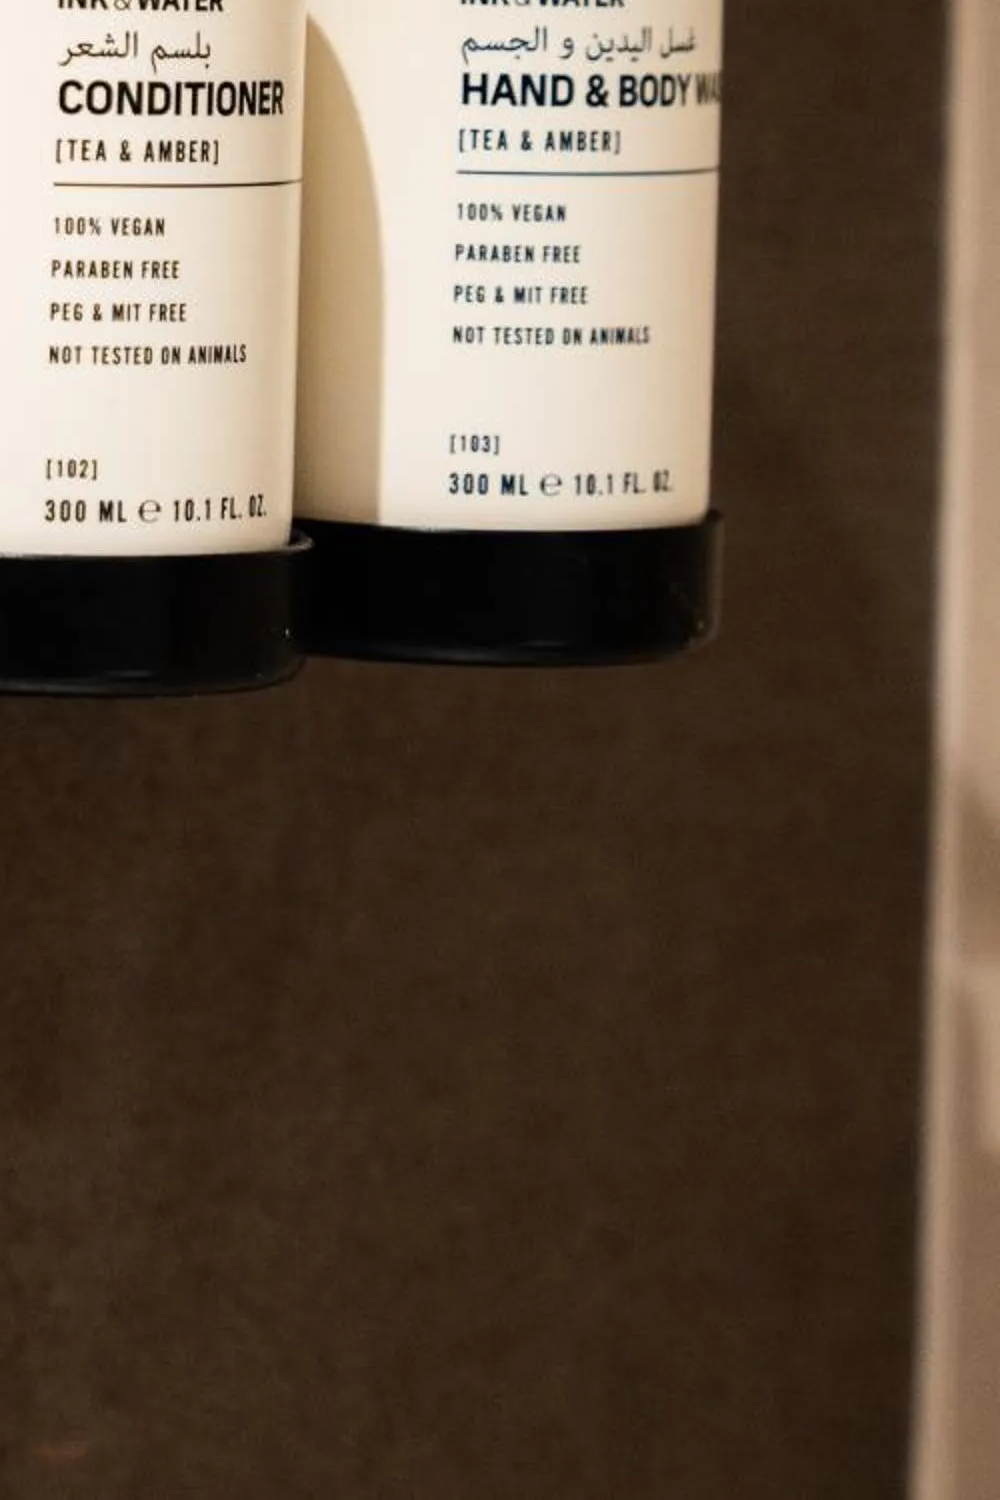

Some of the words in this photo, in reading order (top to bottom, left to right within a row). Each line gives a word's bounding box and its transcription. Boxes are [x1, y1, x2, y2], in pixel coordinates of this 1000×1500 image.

[59, 30, 138, 67] الشعر
[151, 31, 211, 74] بلسم
[461, 26, 548, 65] الجسم
[558, 37, 575, 60] و
[585, 27, 652, 64] اليدين
[59, 79, 284, 116] CONDITIONER
[462, 72, 574, 107] HAND
[585, 74, 609, 108] &
[619, 74, 691, 108] BODY
[56, 138, 107, 164] [TEA
[120, 140, 131, 162] &
[144, 140, 219, 165] AMBER]
[459, 129, 508, 153] [TEA
[520, 130, 533, 151] &
[544, 130, 620, 154] AMBER]
[458, 202, 503, 222] 100%
[512, 204, 566, 222] VEGAN
[55, 216, 101, 236] 100%
[111, 217, 165, 236] VEGAN
[455, 244, 534, 263] PARABEN
[542, 245, 580, 264] FREE
[52, 260, 133, 279] PARABEN
[141, 260, 179, 279] FREE
[454, 284, 485, 304] PEG
[494, 286, 504, 304] &
[514, 286, 542, 303] MIT
[550, 286, 587, 305] FREE
[50, 302, 83, 322] PEG
[92, 303, 102, 322] &
[112, 303, 141, 322] MIT
[149, 303, 186, 322] FREE
[453, 326, 485, 344] NOT
[493, 326, 555, 345] TESTED
[562, 327, 582, 345] ON
[589, 326, 649, 345] ANIMALS
[49, 345, 82, 364] NOT
[91, 345, 153, 365] TESTED
[161, 346, 181, 365] ON
[188, 344, 246, 364] ANIMALS
[450, 434, 500, 456] [103]
[46, 459, 98, 481] [102]
[449, 472, 489, 495] 300
[501, 474, 528, 496] ML
[574, 473, 613, 496] 10.1
[44, 499, 86, 523] 300
[99, 500, 127, 523] ML
[174, 498, 211, 522] 10.1
[220, 497, 242, 520] FL.
